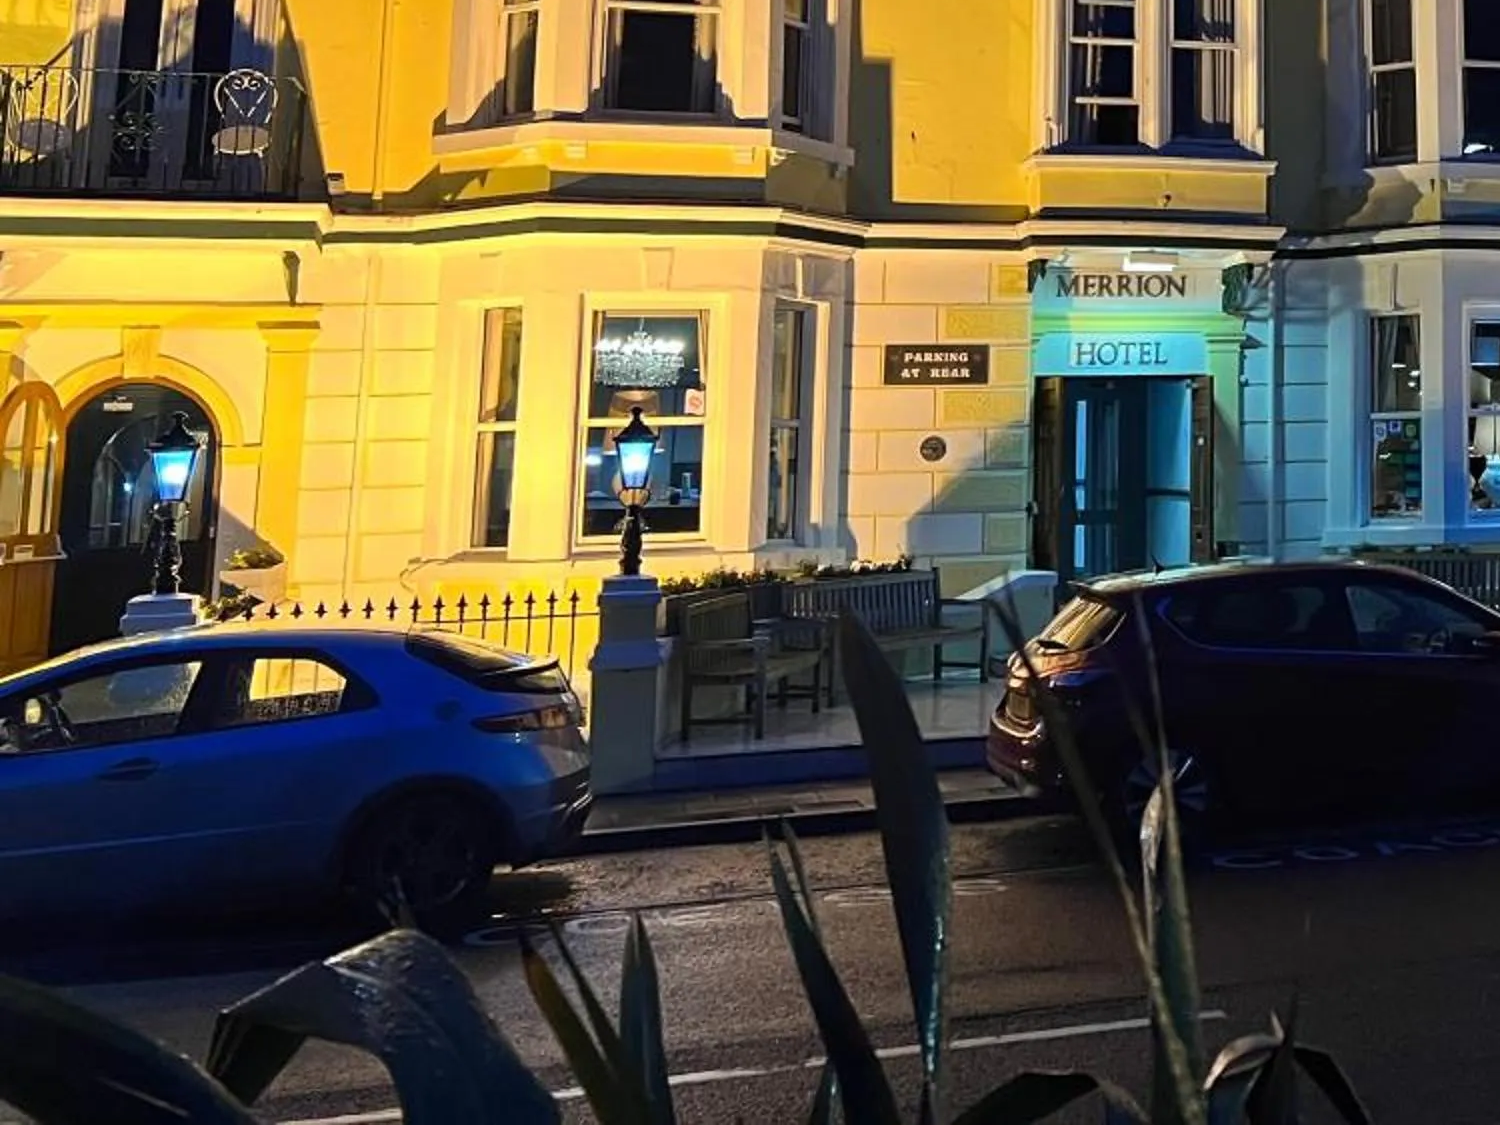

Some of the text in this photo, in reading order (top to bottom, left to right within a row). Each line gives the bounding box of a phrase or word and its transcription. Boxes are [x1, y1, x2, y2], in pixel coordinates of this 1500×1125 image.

[1056, 274, 1187, 298] MERRION
[903, 352, 969, 363] PARKING
[1076, 341, 1168, 365] HOTEL
[901, 368, 970, 378] AT REAR
